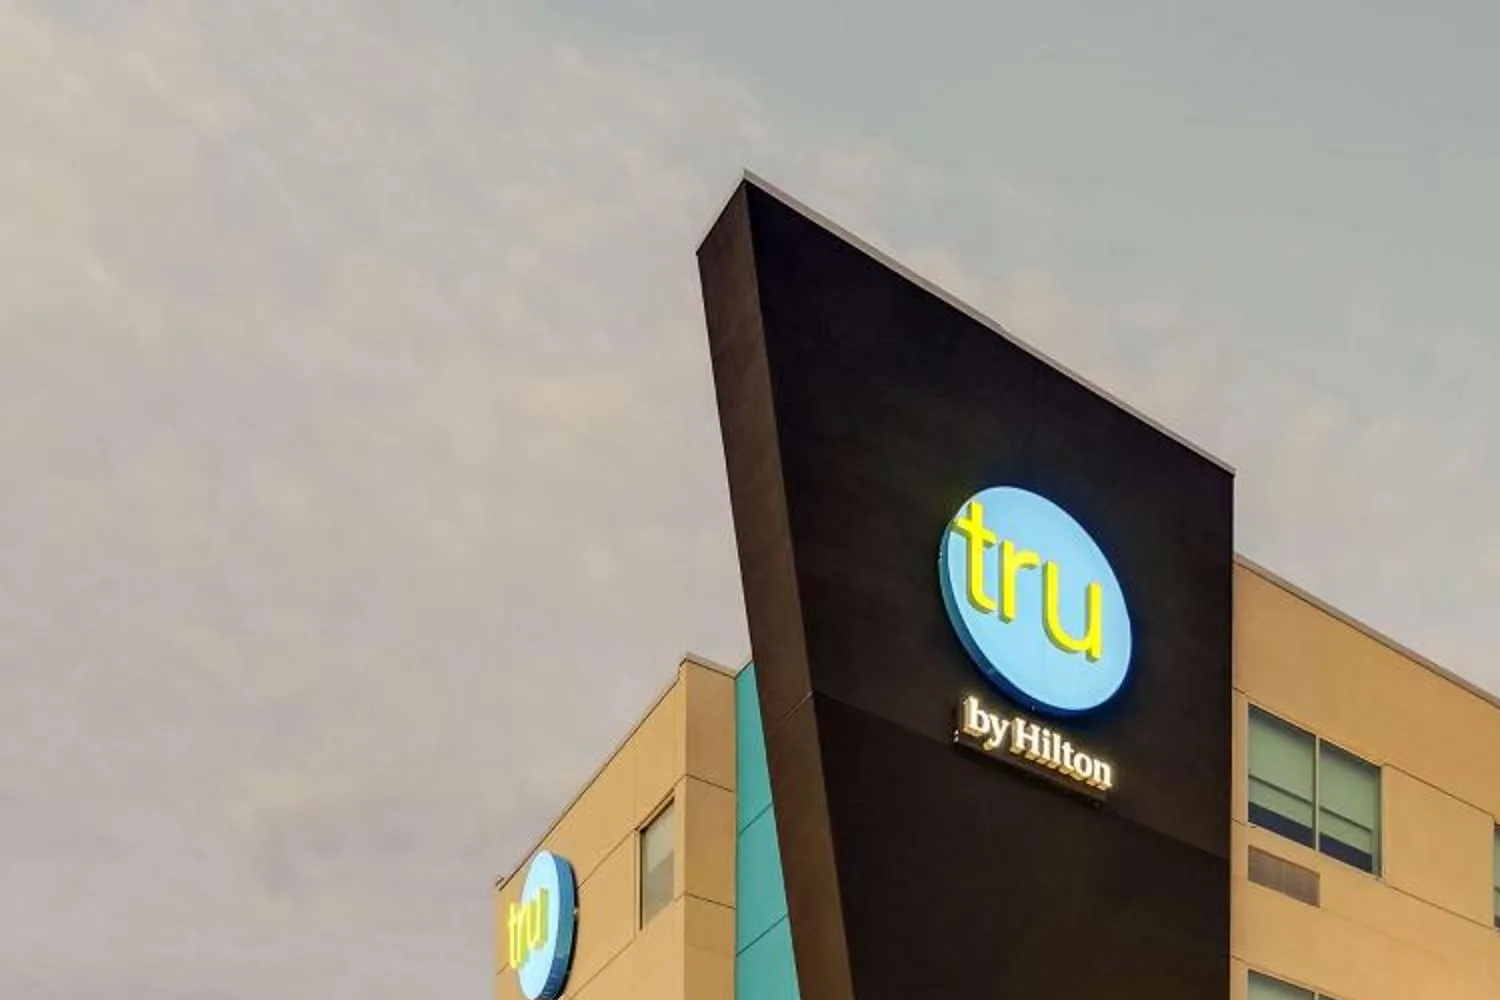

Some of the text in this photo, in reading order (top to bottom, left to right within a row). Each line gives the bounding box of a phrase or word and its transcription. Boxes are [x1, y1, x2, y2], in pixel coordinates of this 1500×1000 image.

[952, 500, 1102, 662] tru
[964, 696, 1113, 790] by Hilton
[508, 887, 549, 968] tru
